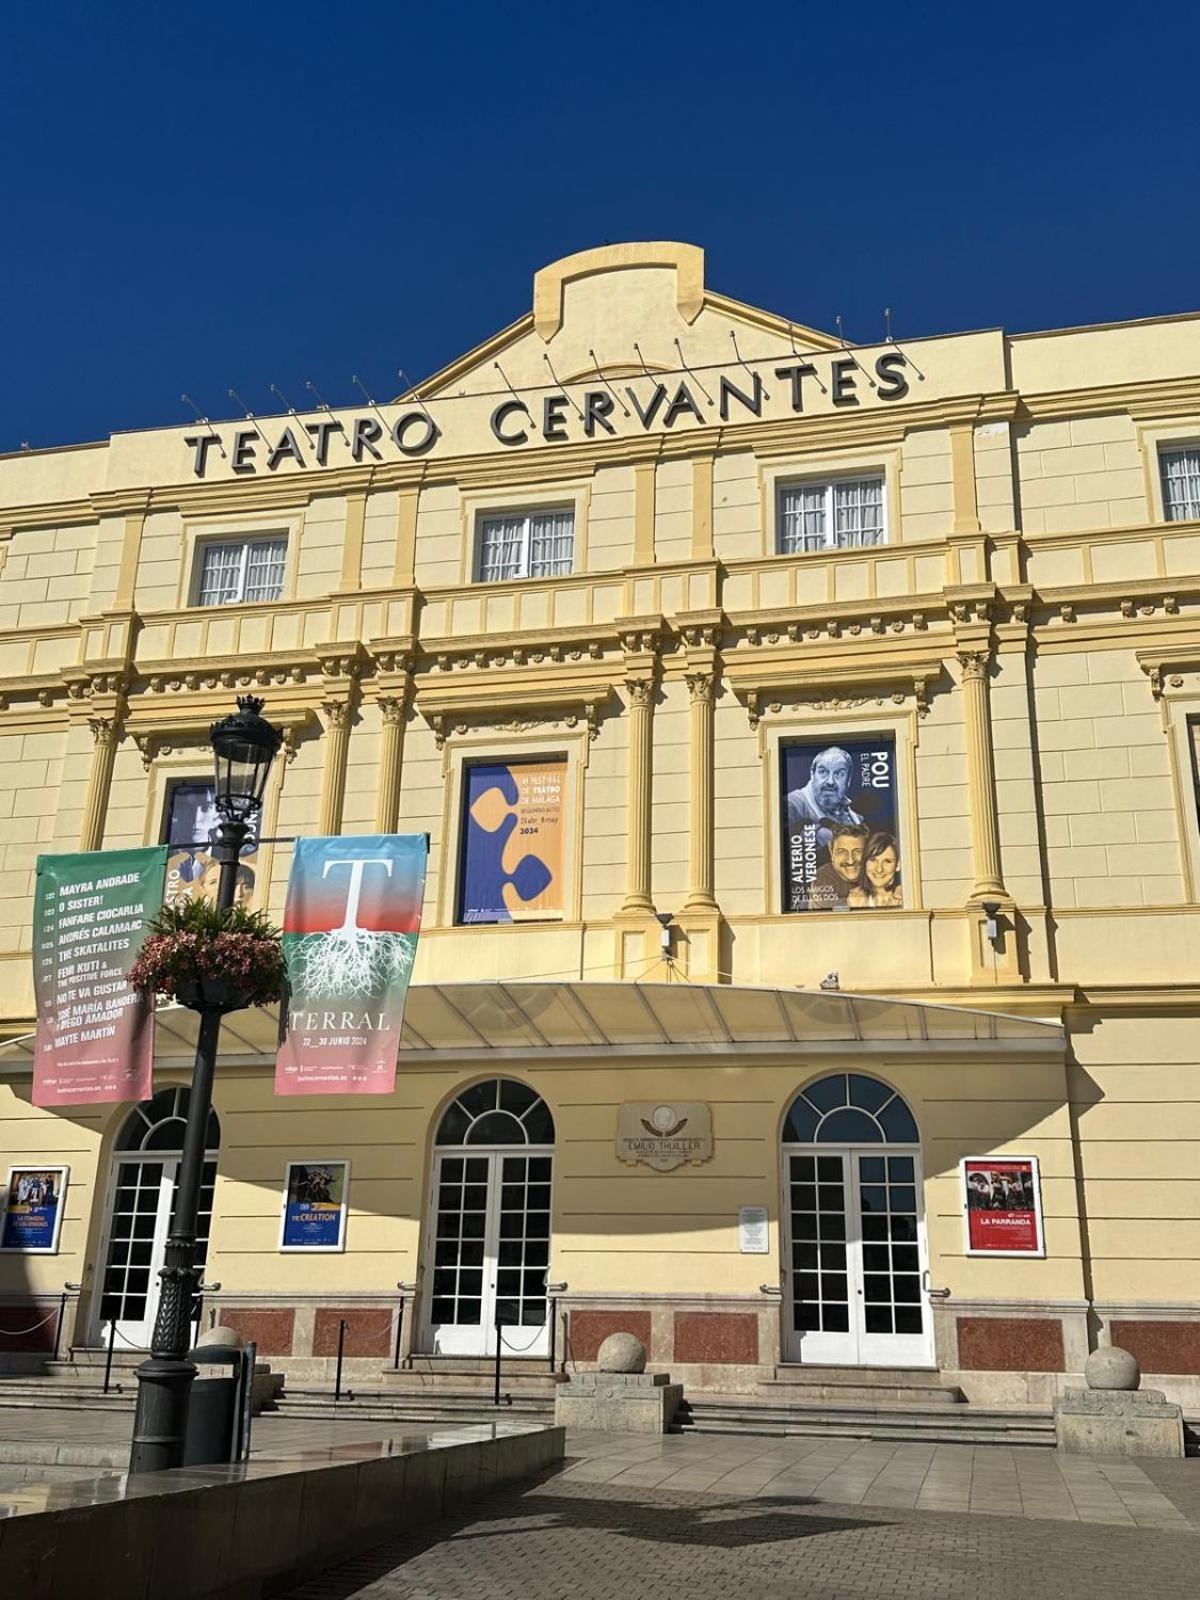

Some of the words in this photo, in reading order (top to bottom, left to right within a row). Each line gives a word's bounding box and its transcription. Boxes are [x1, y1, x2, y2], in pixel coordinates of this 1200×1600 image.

[184, 411, 441, 478] TEATRO
[489, 352, 909, 447] CERVANTES
[860, 752, 869, 762] EL
[871, 752, 890, 788] POU
[533, 786, 560, 794] TEATRO
[791, 835, 803, 884] ALTERIO
[804, 824, 817, 884] VERONESE
[59, 881, 94, 896] MAYRA
[95, 872, 140, 890] ANDRADE
[67, 895, 104, 911] SISTER!
[58, 912, 96, 930] FANFARE
[96, 903, 144, 921] CIOCARLIA
[58, 926, 91, 946] ANDRÉS
[74, 938, 130, 958] SKATALITES
[77, 960, 100, 974] KUTI
[78, 988, 91, 999] VA
[72, 999, 103, 1016] MARÍA
[84, 1008, 124, 1024] AMADOR
[288, 1011, 390, 1031] TERRAL
[54, 1032, 79, 1049] MAYTE
[328, 1036, 350, 1046] JUNIO
[351, 1036, 367, 1046] 2024
[628, 1141, 656, 1150] EMILIO
